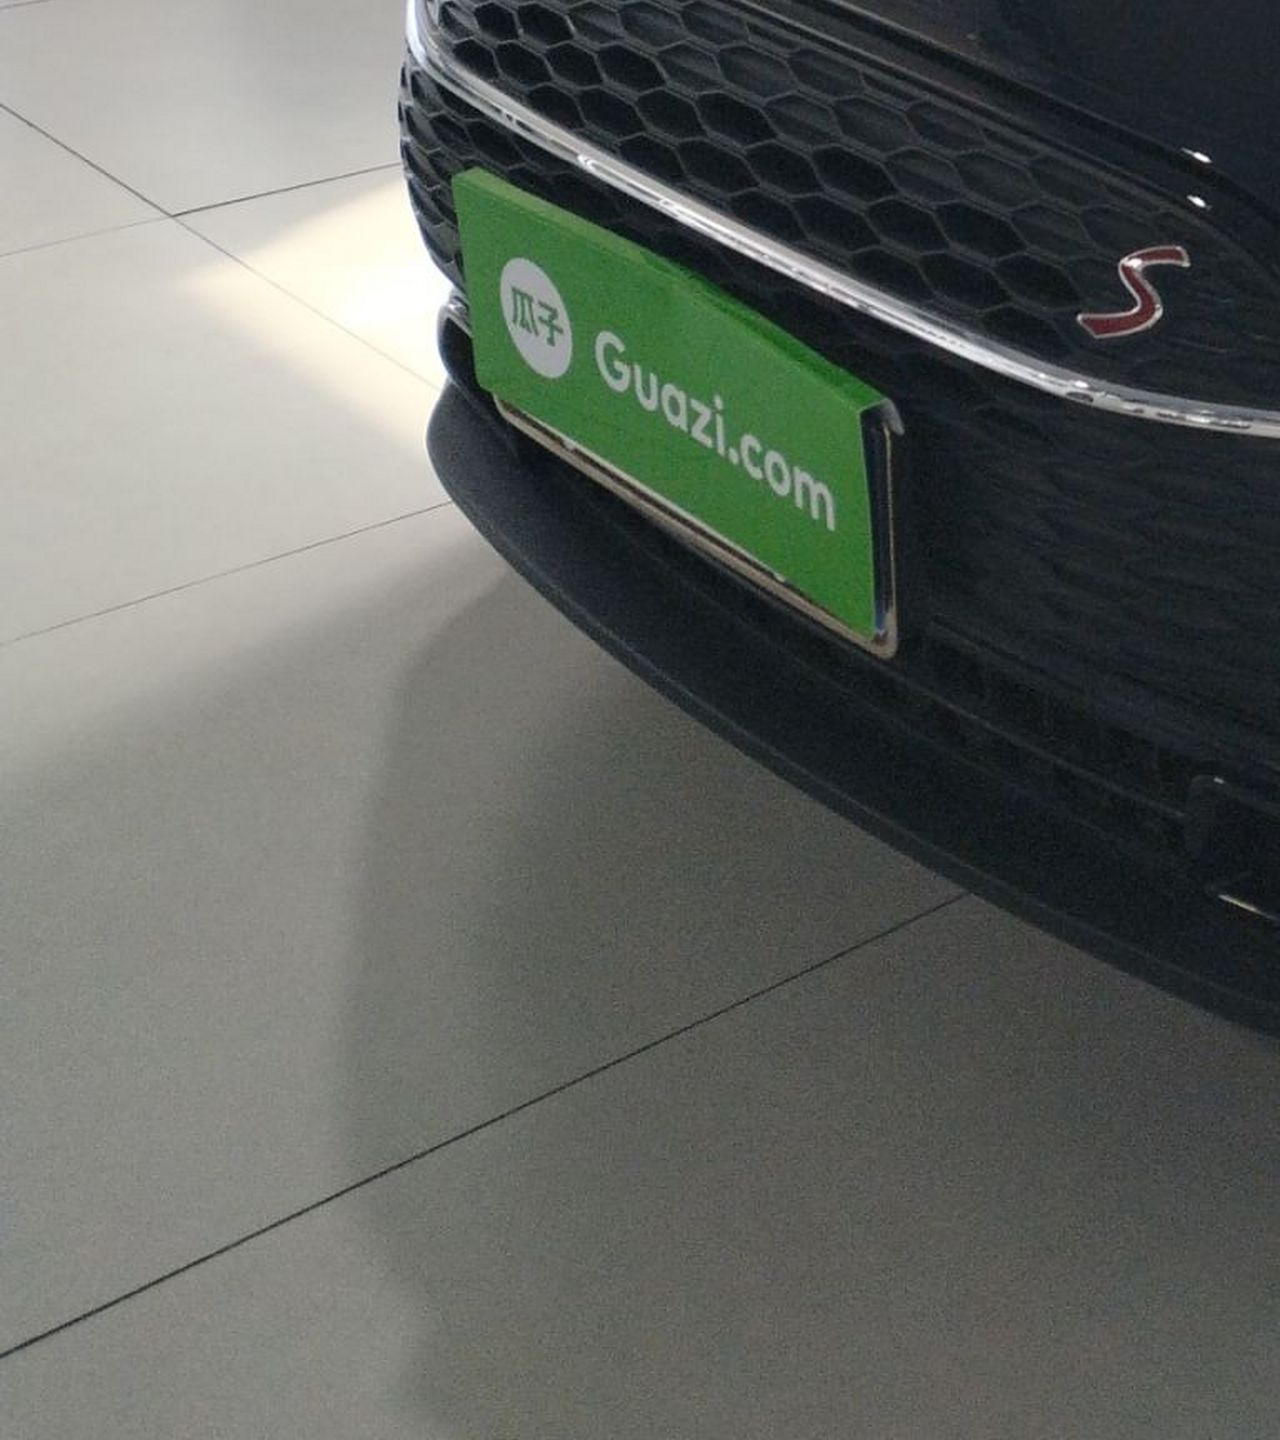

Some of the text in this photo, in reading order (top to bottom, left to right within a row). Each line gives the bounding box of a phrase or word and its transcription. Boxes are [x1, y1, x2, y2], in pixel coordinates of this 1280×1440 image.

[511, 286, 564, 348] 瓜子
[1076, 245, 1191, 339] S
[595, 330, 836, 532] Guazi.com
